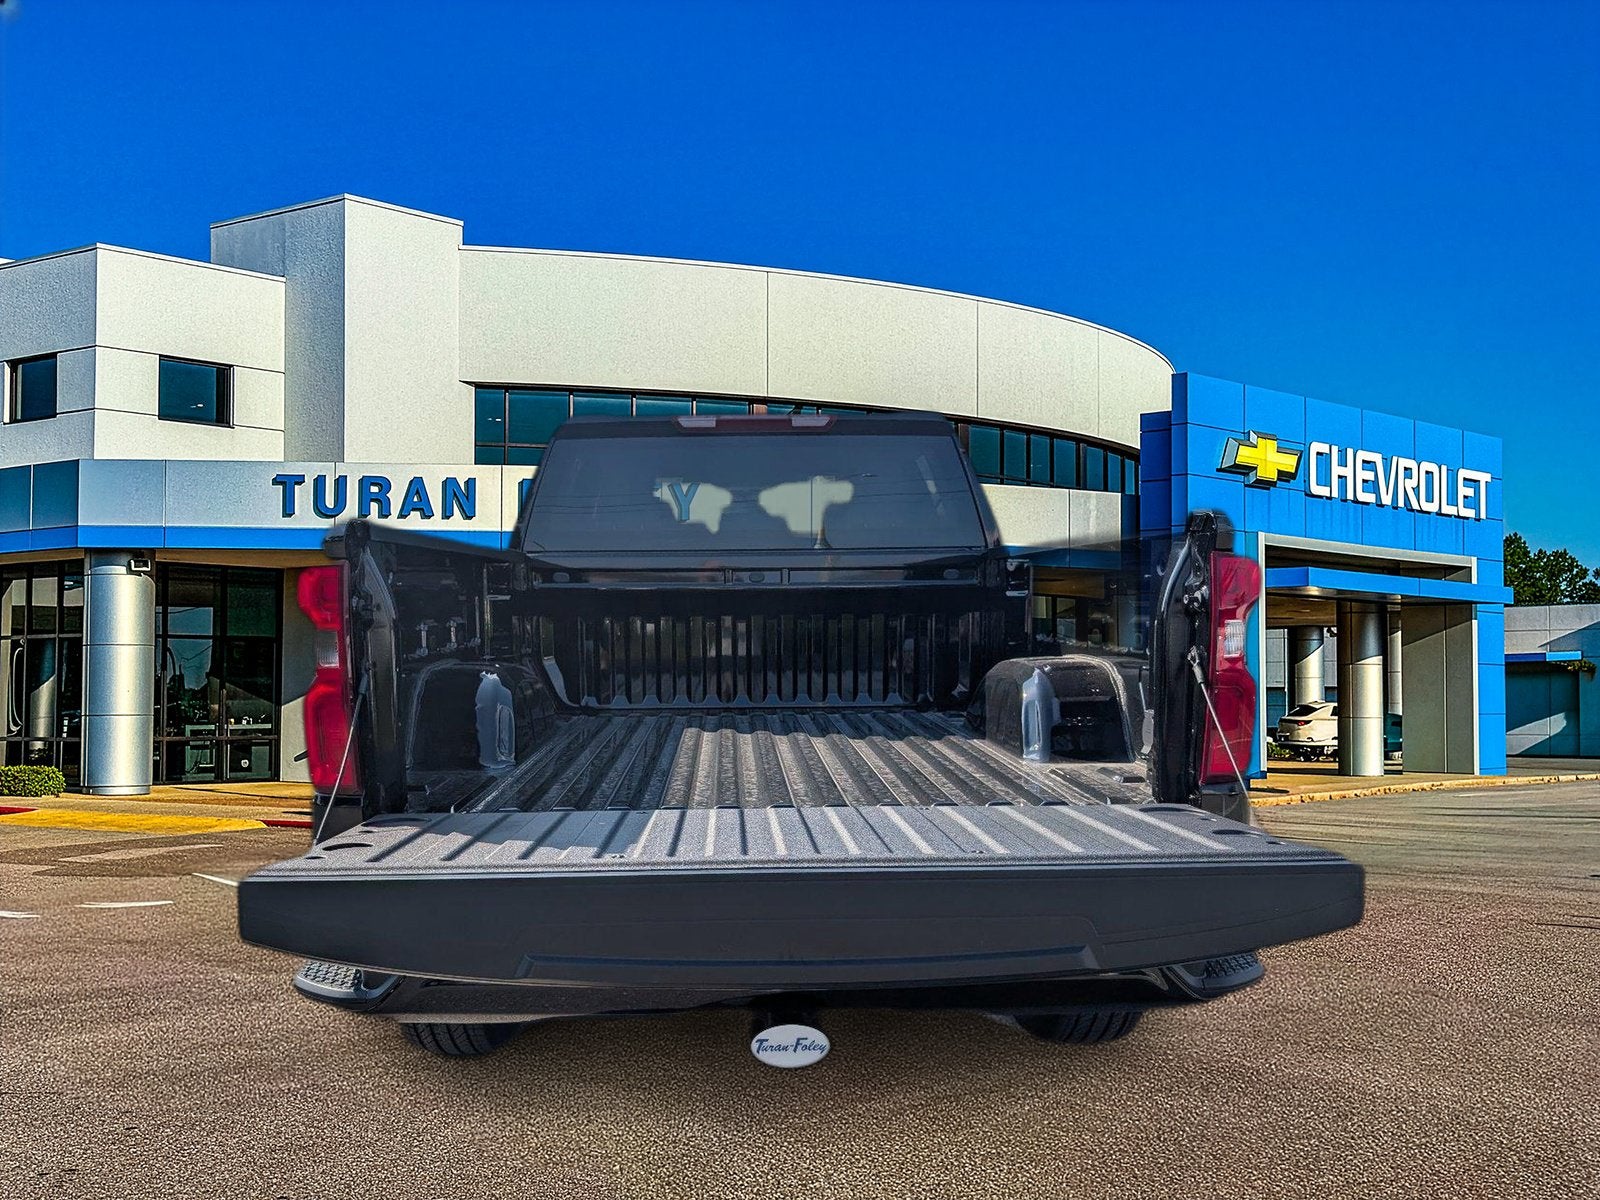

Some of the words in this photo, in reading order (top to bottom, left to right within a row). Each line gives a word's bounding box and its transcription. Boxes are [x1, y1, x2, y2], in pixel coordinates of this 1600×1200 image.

[272, 474, 476, 520] TURAN
[1308, 441, 1492, 521] CHEVROLET
[755, 1037, 827, 1054] Turan-Foley
